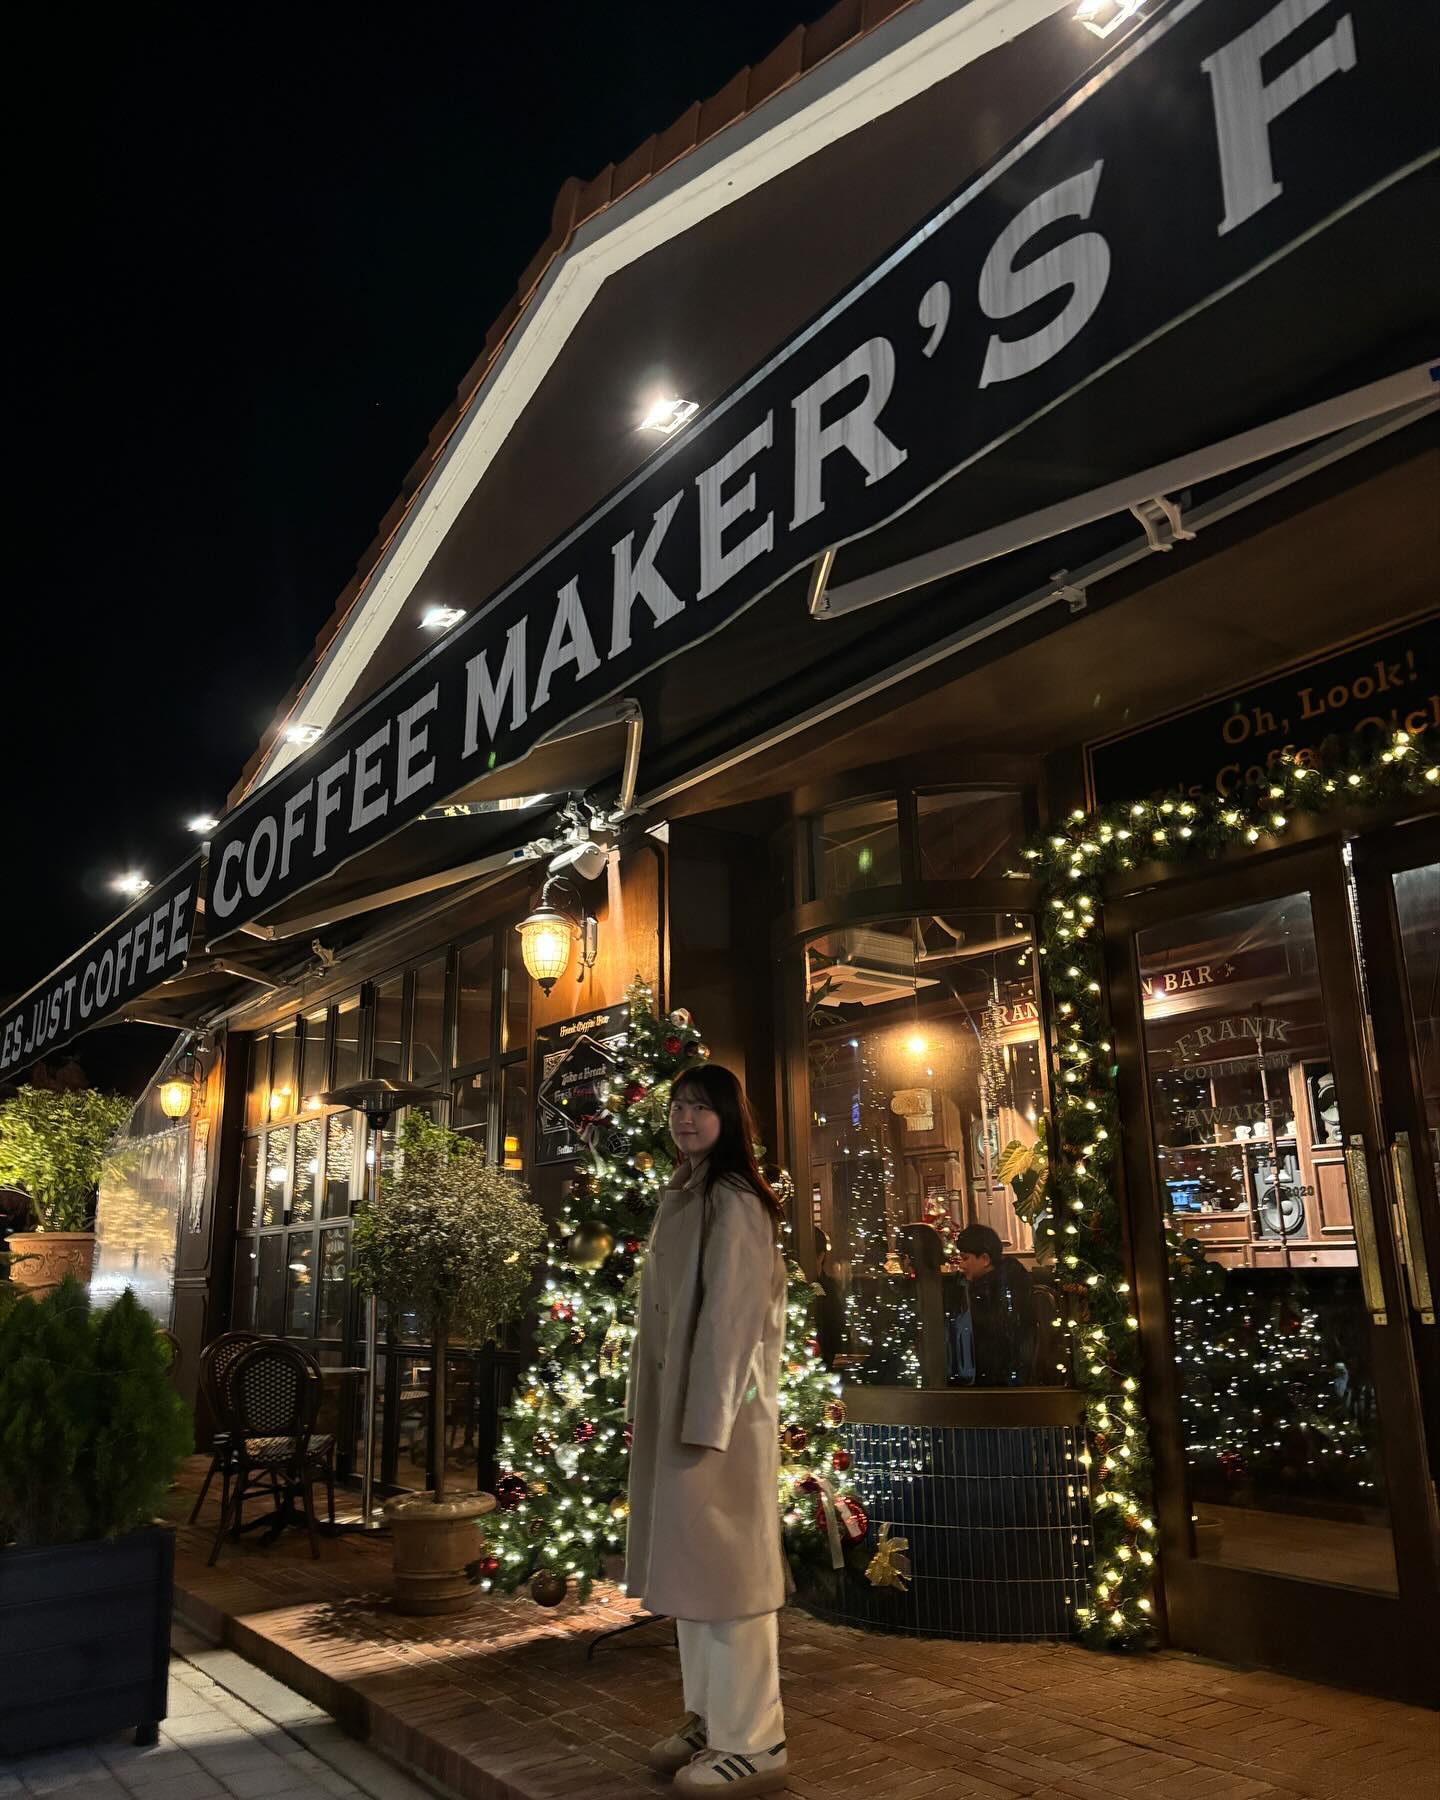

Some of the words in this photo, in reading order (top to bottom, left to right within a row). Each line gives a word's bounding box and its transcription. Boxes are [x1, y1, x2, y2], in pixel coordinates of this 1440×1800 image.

[212, 682, 439, 918] COFFEE
[462, 159, 1111, 759] MAKER'S
[1223, 707, 1290, 744] Oh,
[1298, 650, 1417, 719] Look!
[24, 976, 77, 1054] JUST
[80, 886, 193, 1018] COFFEE
[1164, 964, 1214, 992] BAR
[1175, 1016, 1291, 1058] FRANK
